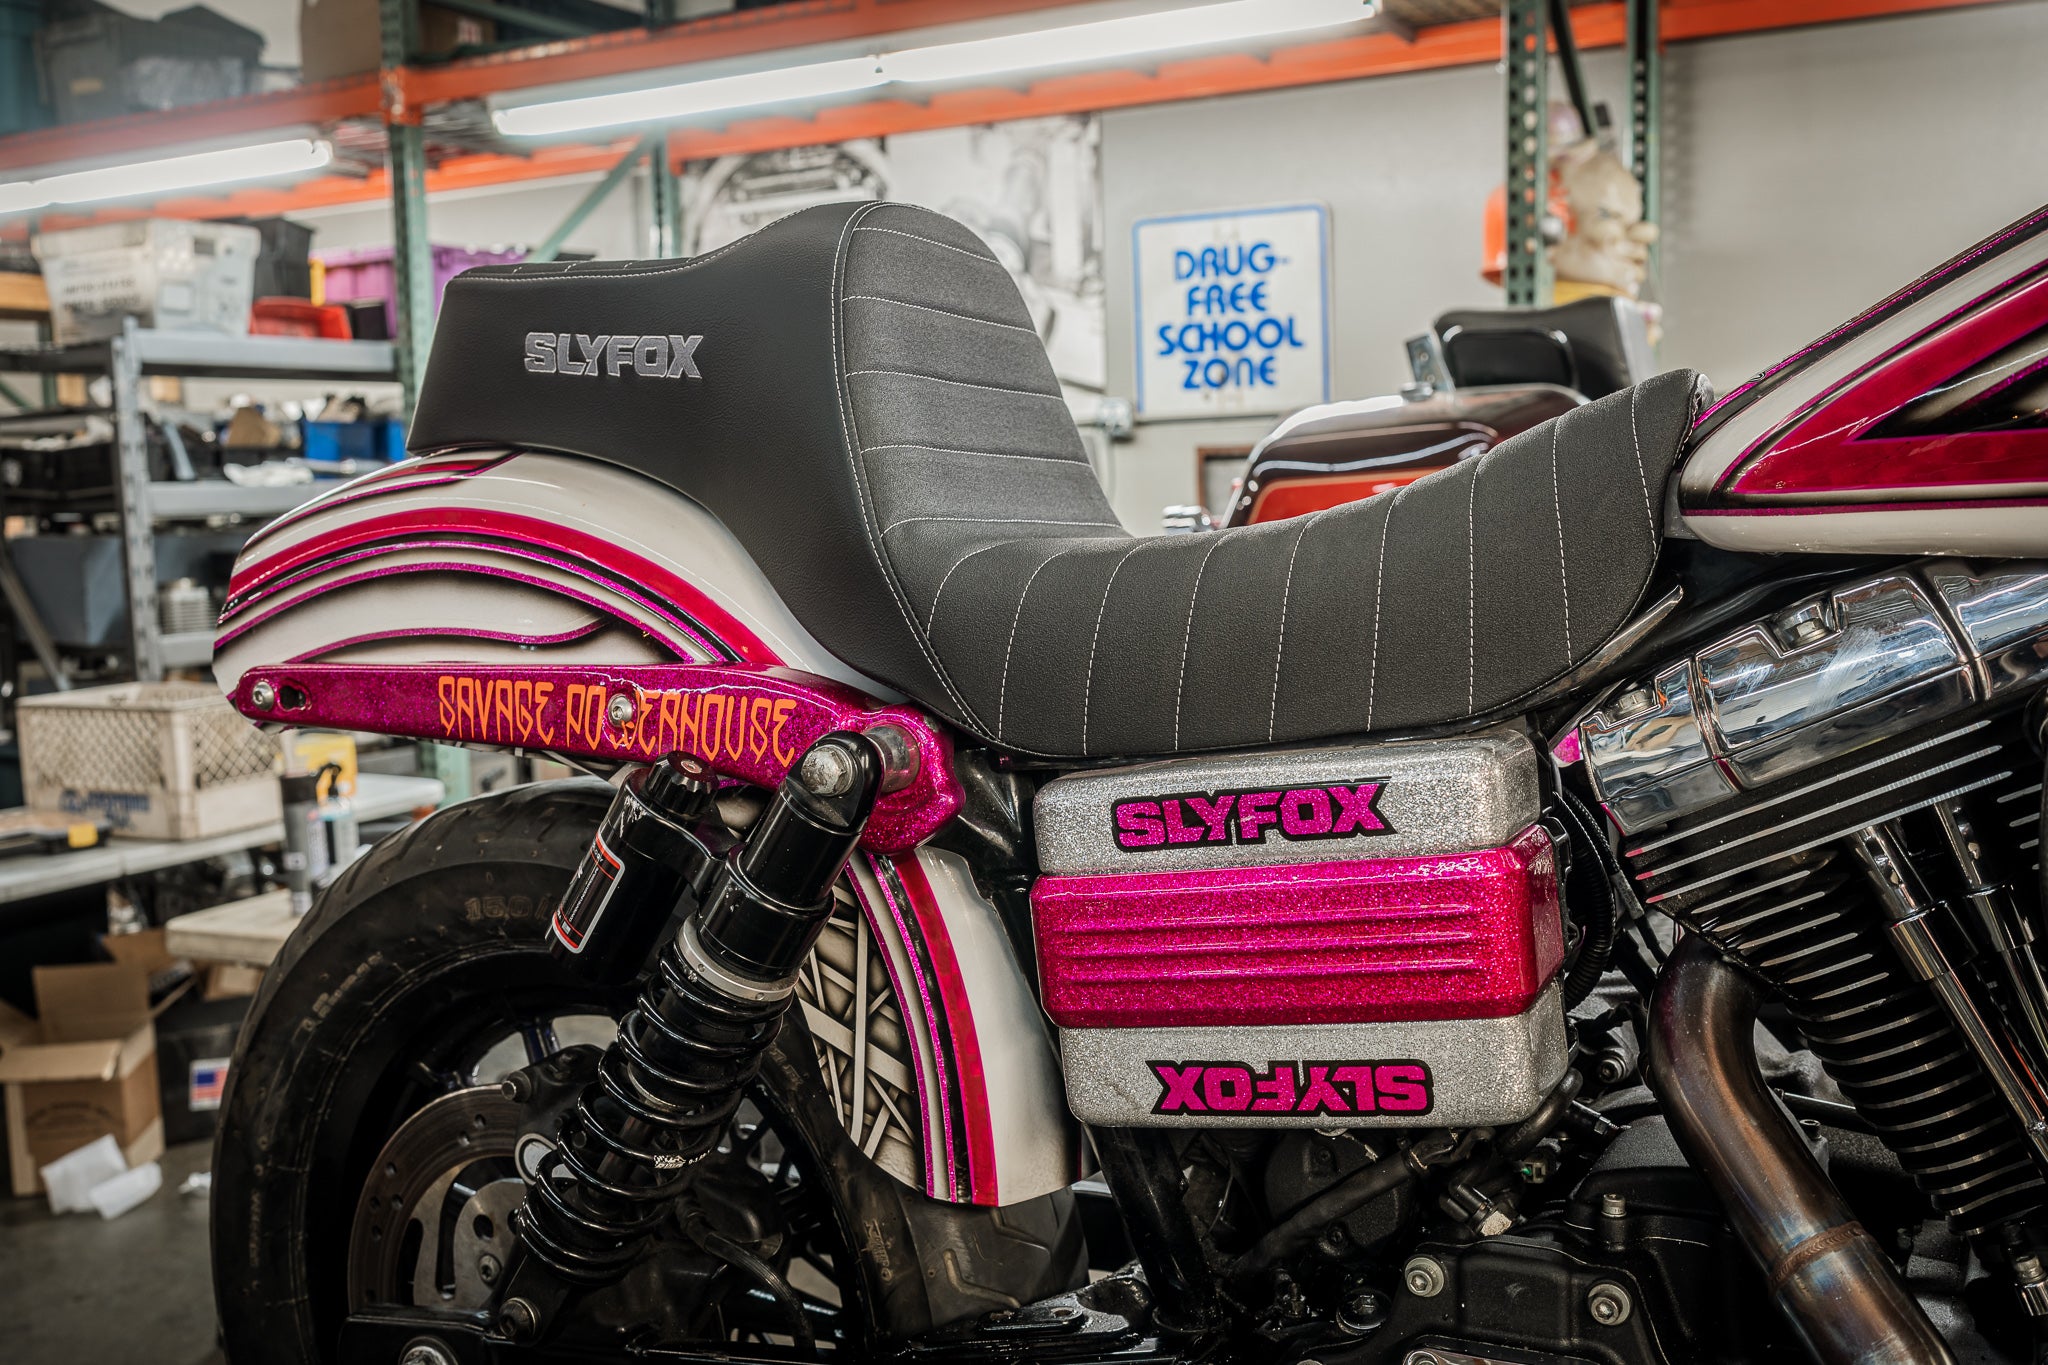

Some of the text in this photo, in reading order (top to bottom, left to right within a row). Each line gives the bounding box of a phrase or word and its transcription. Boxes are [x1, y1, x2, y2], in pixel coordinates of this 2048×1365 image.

[1175, 243, 1290, 280] DRUG-
[1187, 281, 1267, 316] FREE
[524, 331, 704, 379] SLYFOX
[1158, 317, 1304, 356] SCHOOL
[1183, 356, 1276, 389] ZONE
[438, 676, 555, 746] SAVAGE
[1113, 780, 1394, 851] SLYFOX
[1150, 1062, 1432, 1115] SLYFOX
